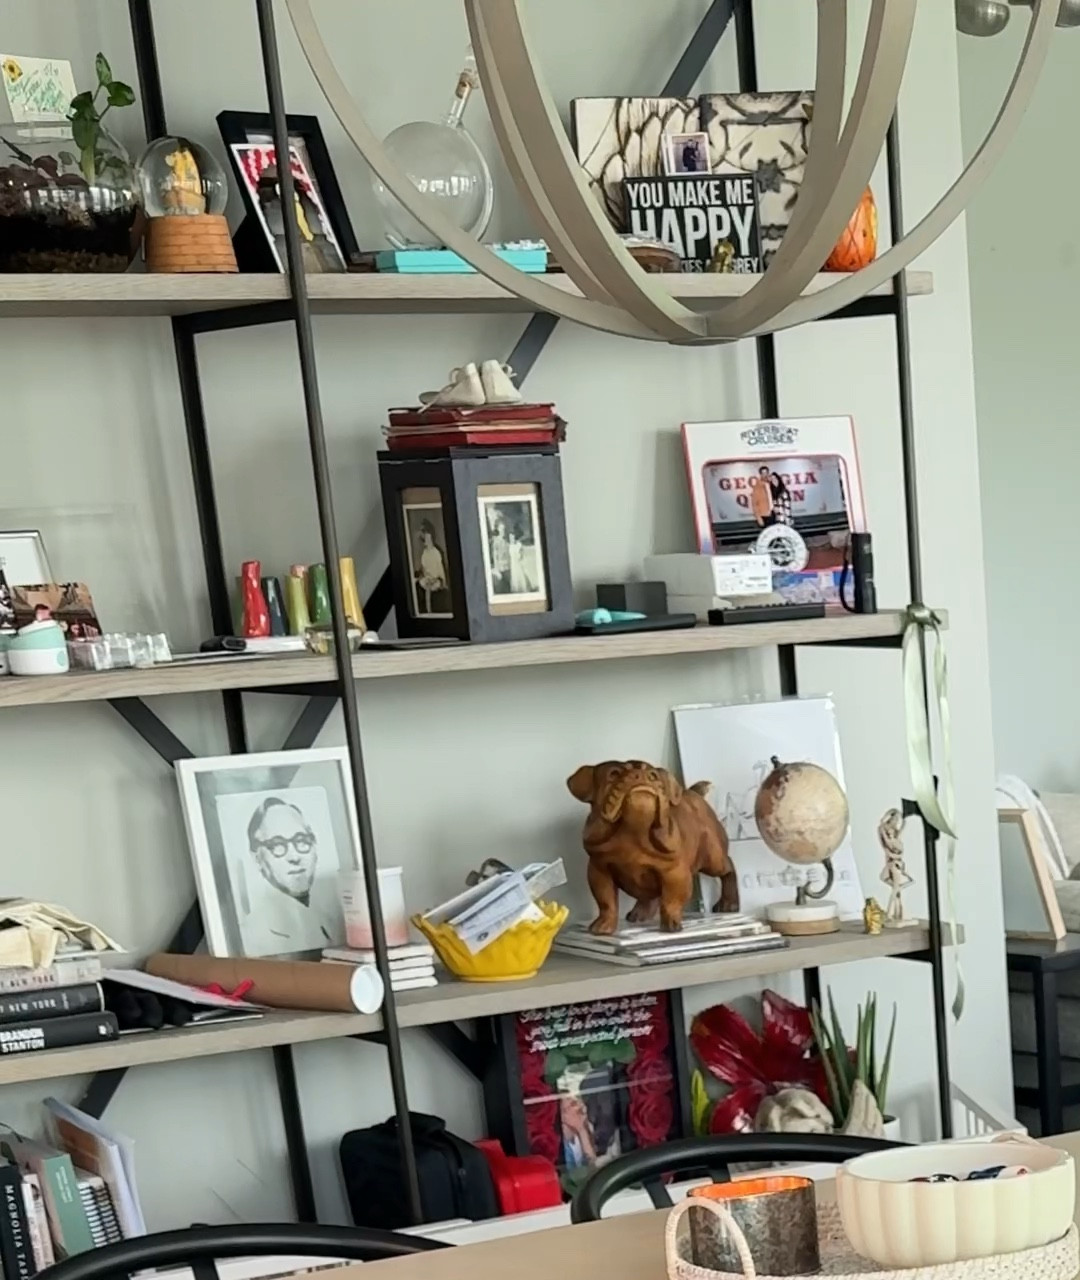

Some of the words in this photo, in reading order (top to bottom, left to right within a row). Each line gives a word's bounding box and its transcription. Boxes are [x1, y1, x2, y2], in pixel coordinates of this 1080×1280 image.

[627, 182, 663, 208] YOU
[668, 180, 722, 207] MAKE
[725, 179, 754, 204] ME
[631, 206, 755, 258] HAPPY
[5, 1185, 22, 1248] MAGNOLIA
